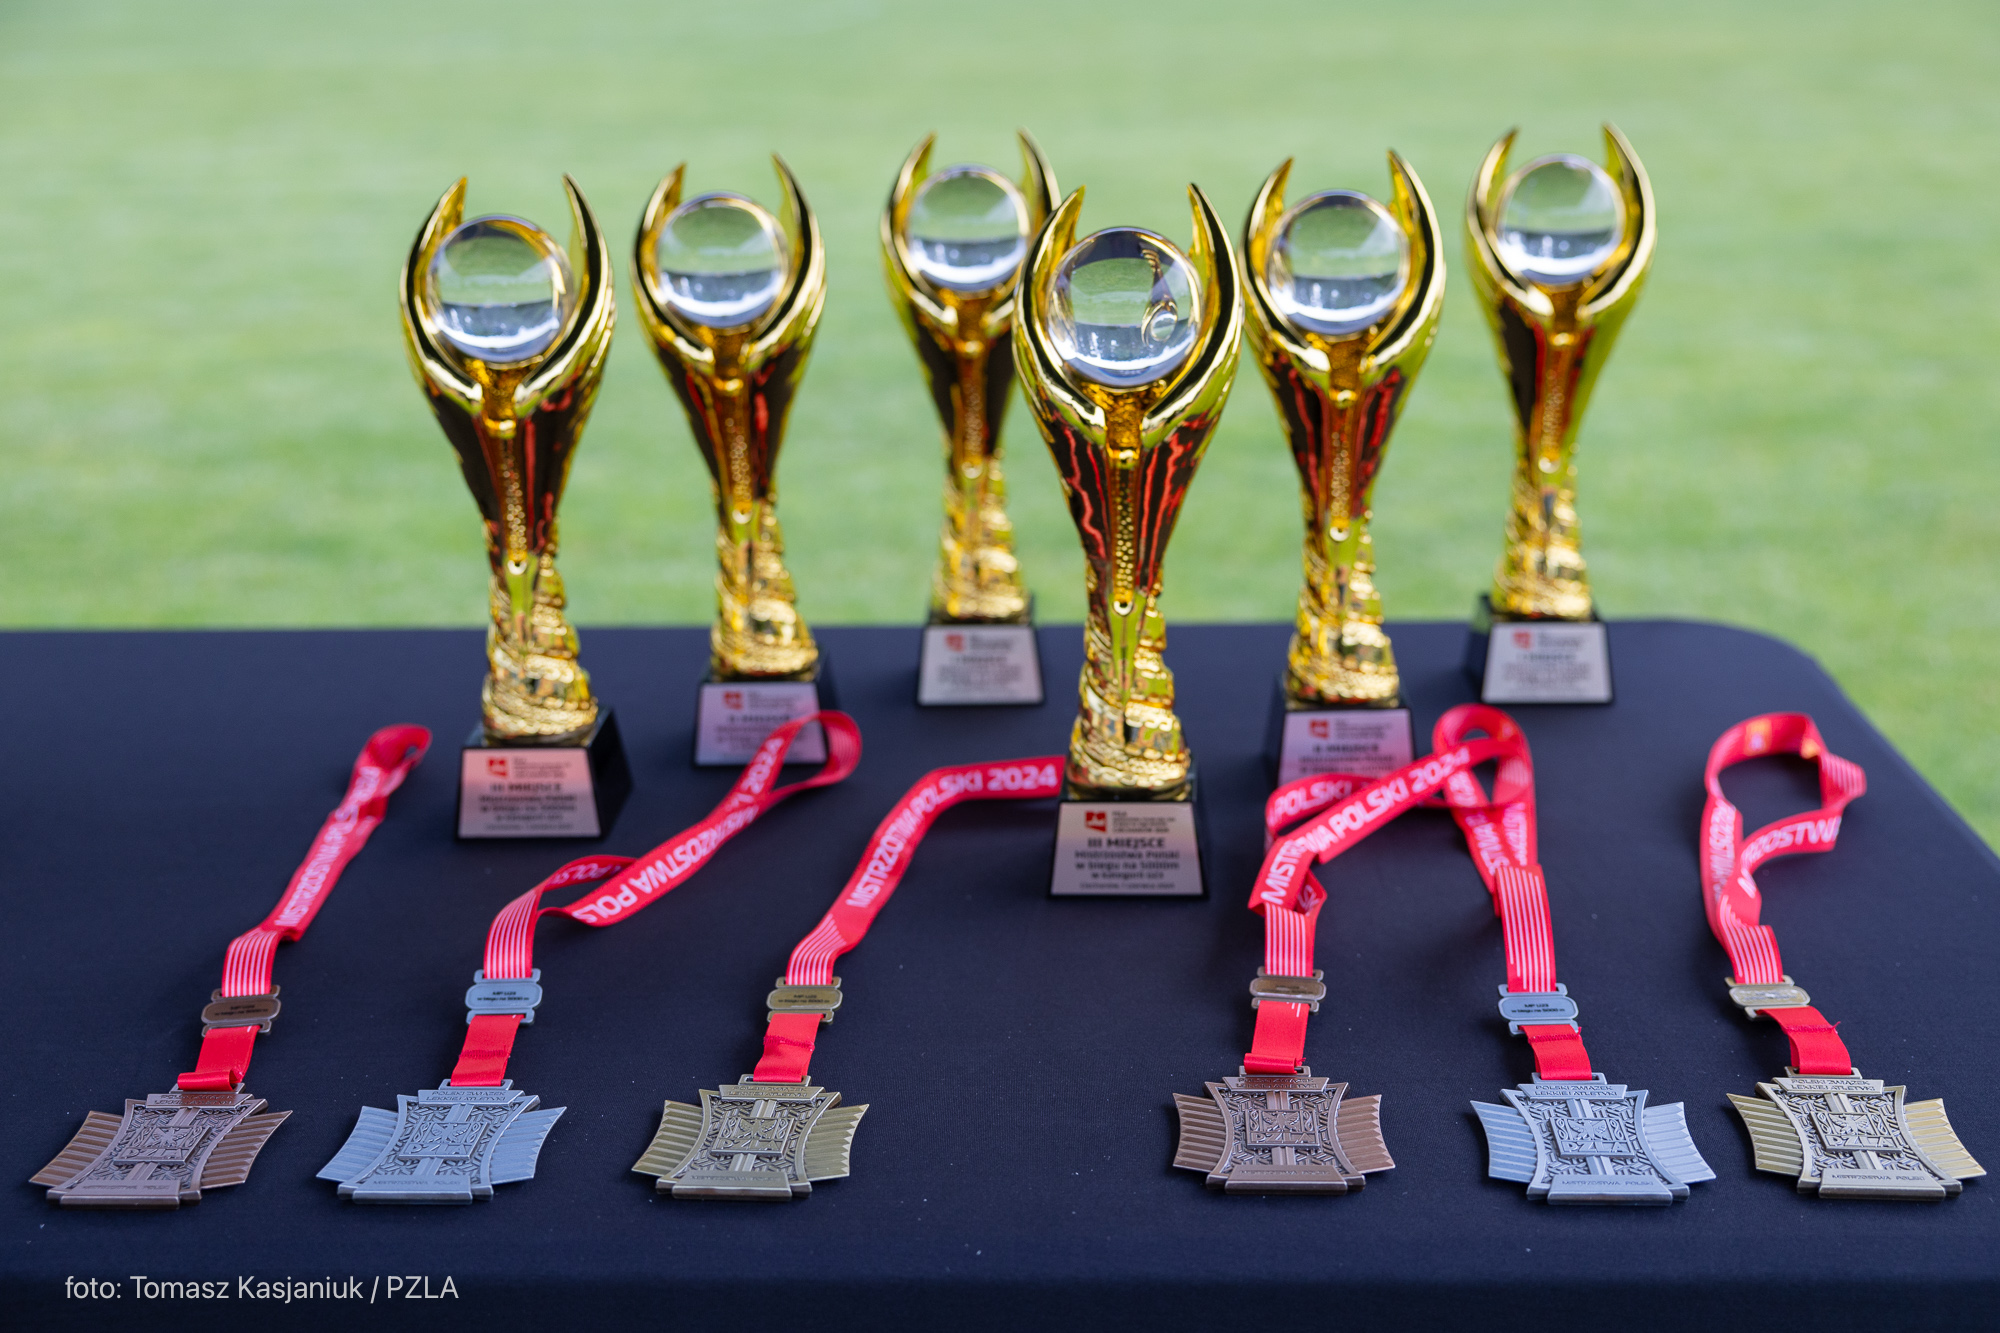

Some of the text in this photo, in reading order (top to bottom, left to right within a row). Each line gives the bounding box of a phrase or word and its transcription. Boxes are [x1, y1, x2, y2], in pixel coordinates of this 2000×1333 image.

[987, 764, 1058, 792] 2024
[1328, 778, 1409, 840] POLSKI
[1409, 747, 1471, 794] 2024
[1087, 838, 1165, 849] III MIEJSCE
[572, 884, 638, 923] POLS
[1250, 1132, 1315, 1143] PZLA
[1827, 1135, 1895, 1148] PZLA
[407, 1143, 470, 1155] PZLA
[1562, 1140, 1630, 1153] PZLA
